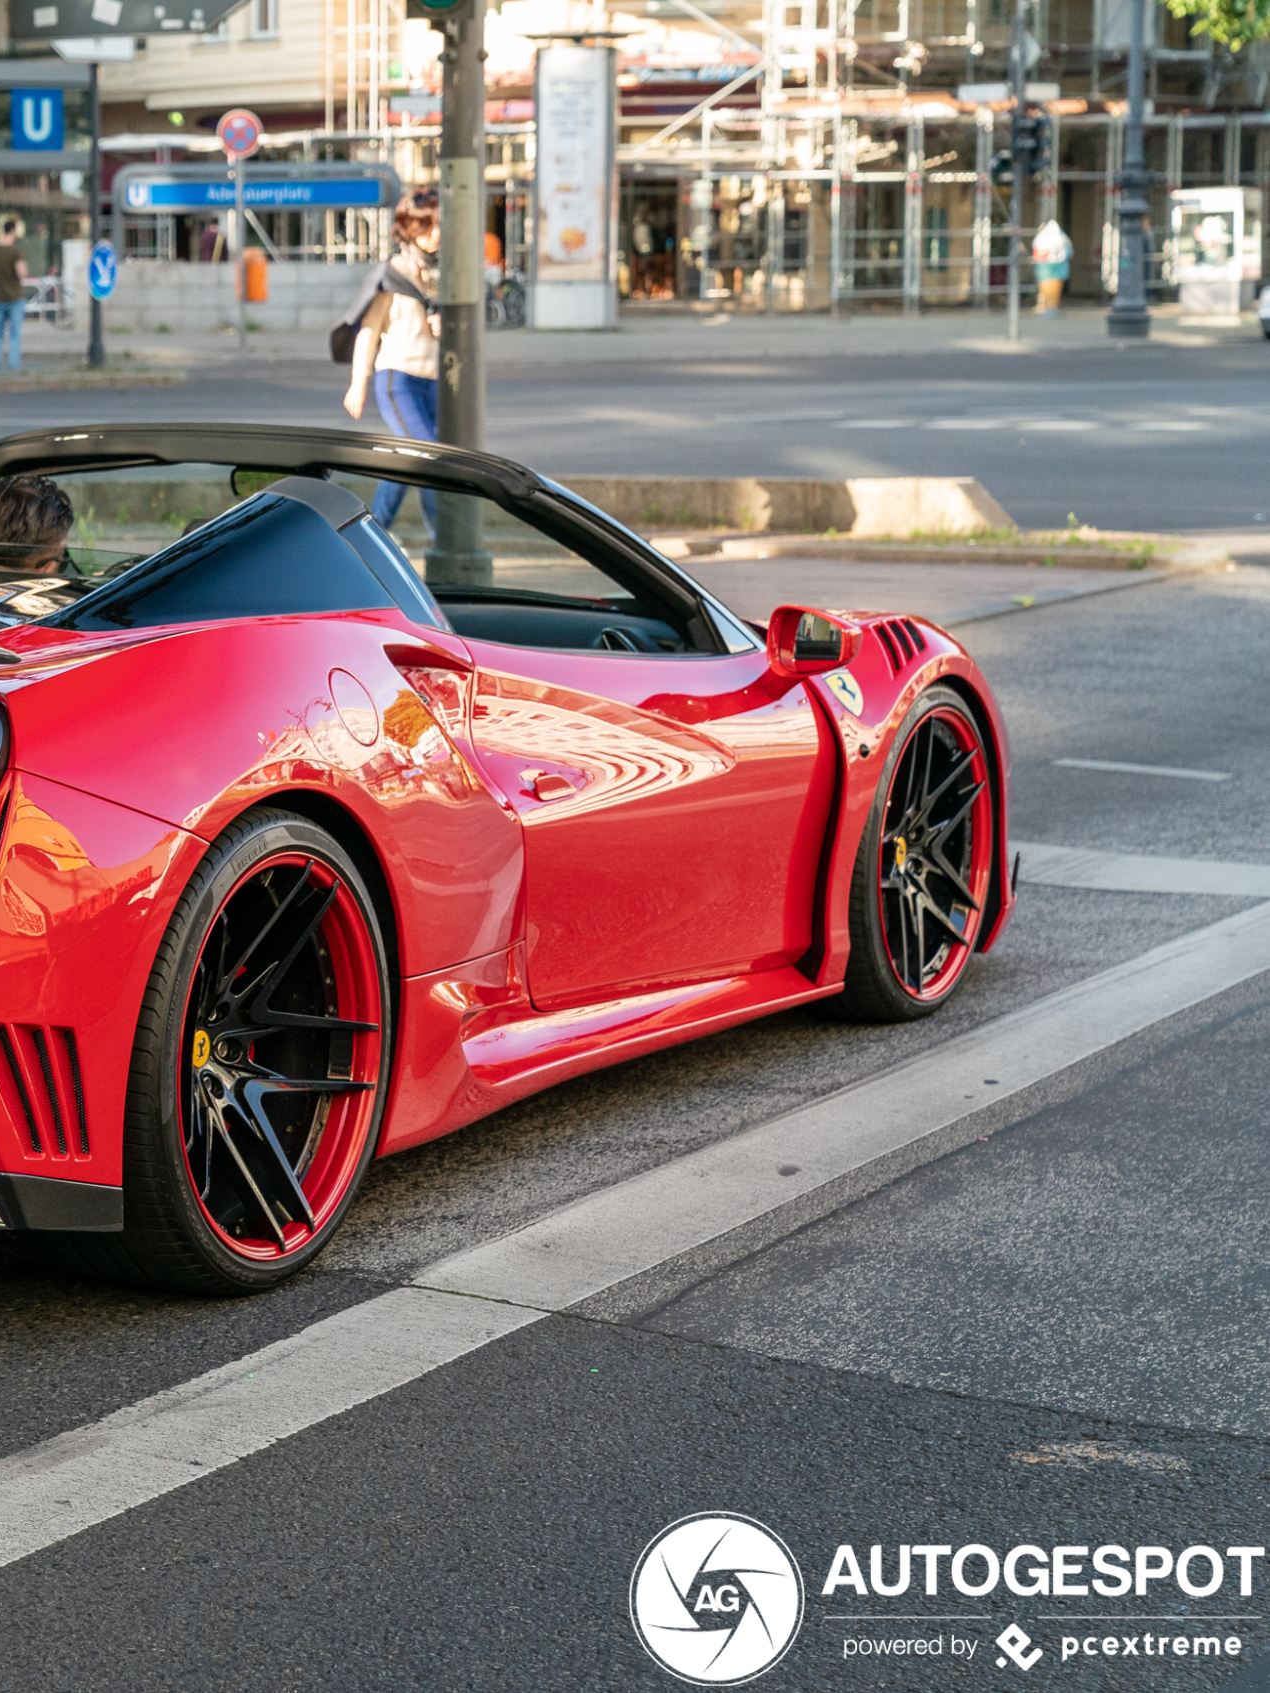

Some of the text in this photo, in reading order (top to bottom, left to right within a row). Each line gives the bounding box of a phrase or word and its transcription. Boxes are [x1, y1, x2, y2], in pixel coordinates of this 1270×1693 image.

[23, 97, 53, 142] U
[129, 184, 312, 207] U Adeauerplatz
